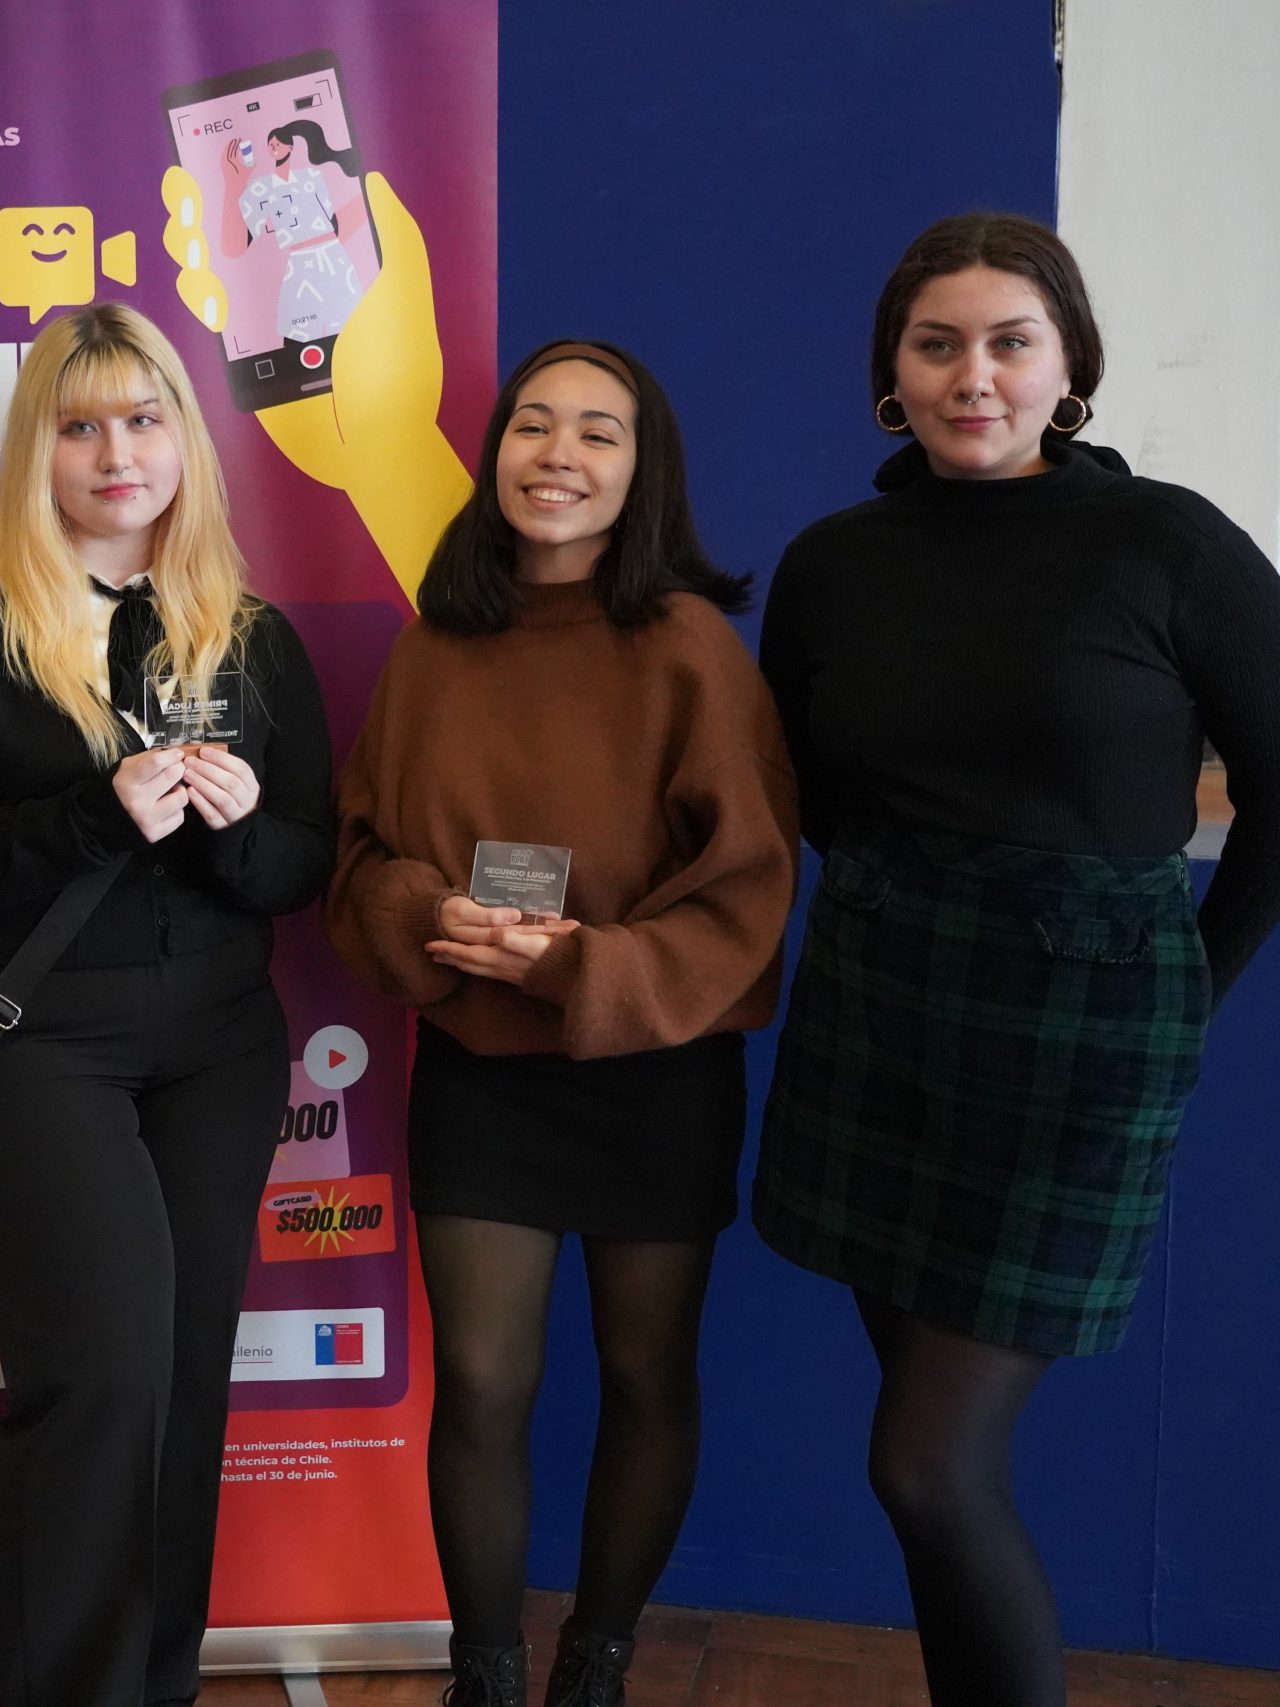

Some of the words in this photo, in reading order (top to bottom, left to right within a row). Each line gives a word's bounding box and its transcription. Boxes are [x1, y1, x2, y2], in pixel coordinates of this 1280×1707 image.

[203, 118, 234, 136] REC
[483, 866, 525, 877] SEGUNDO
[527, 871, 557, 881] LUGAR
[273, 1195, 312, 1207] GIFTCARD
[276, 1204, 382, 1234] $500.000
[243, 1440, 328, 1451] universidades,
[331, 1438, 387, 1449] institutos
[390, 1438, 405, 1447] de
[235, 1456, 278, 1466] técnica
[281, 1455, 296, 1465] de
[299, 1455, 332, 1464] Chile.
[221, 1472, 253, 1481] hasta
[256, 1471, 266, 1480] el
[269, 1471, 284, 1480] 30
[287, 1470, 302, 1480] de
[304, 1469, 337, 1481] junio.
